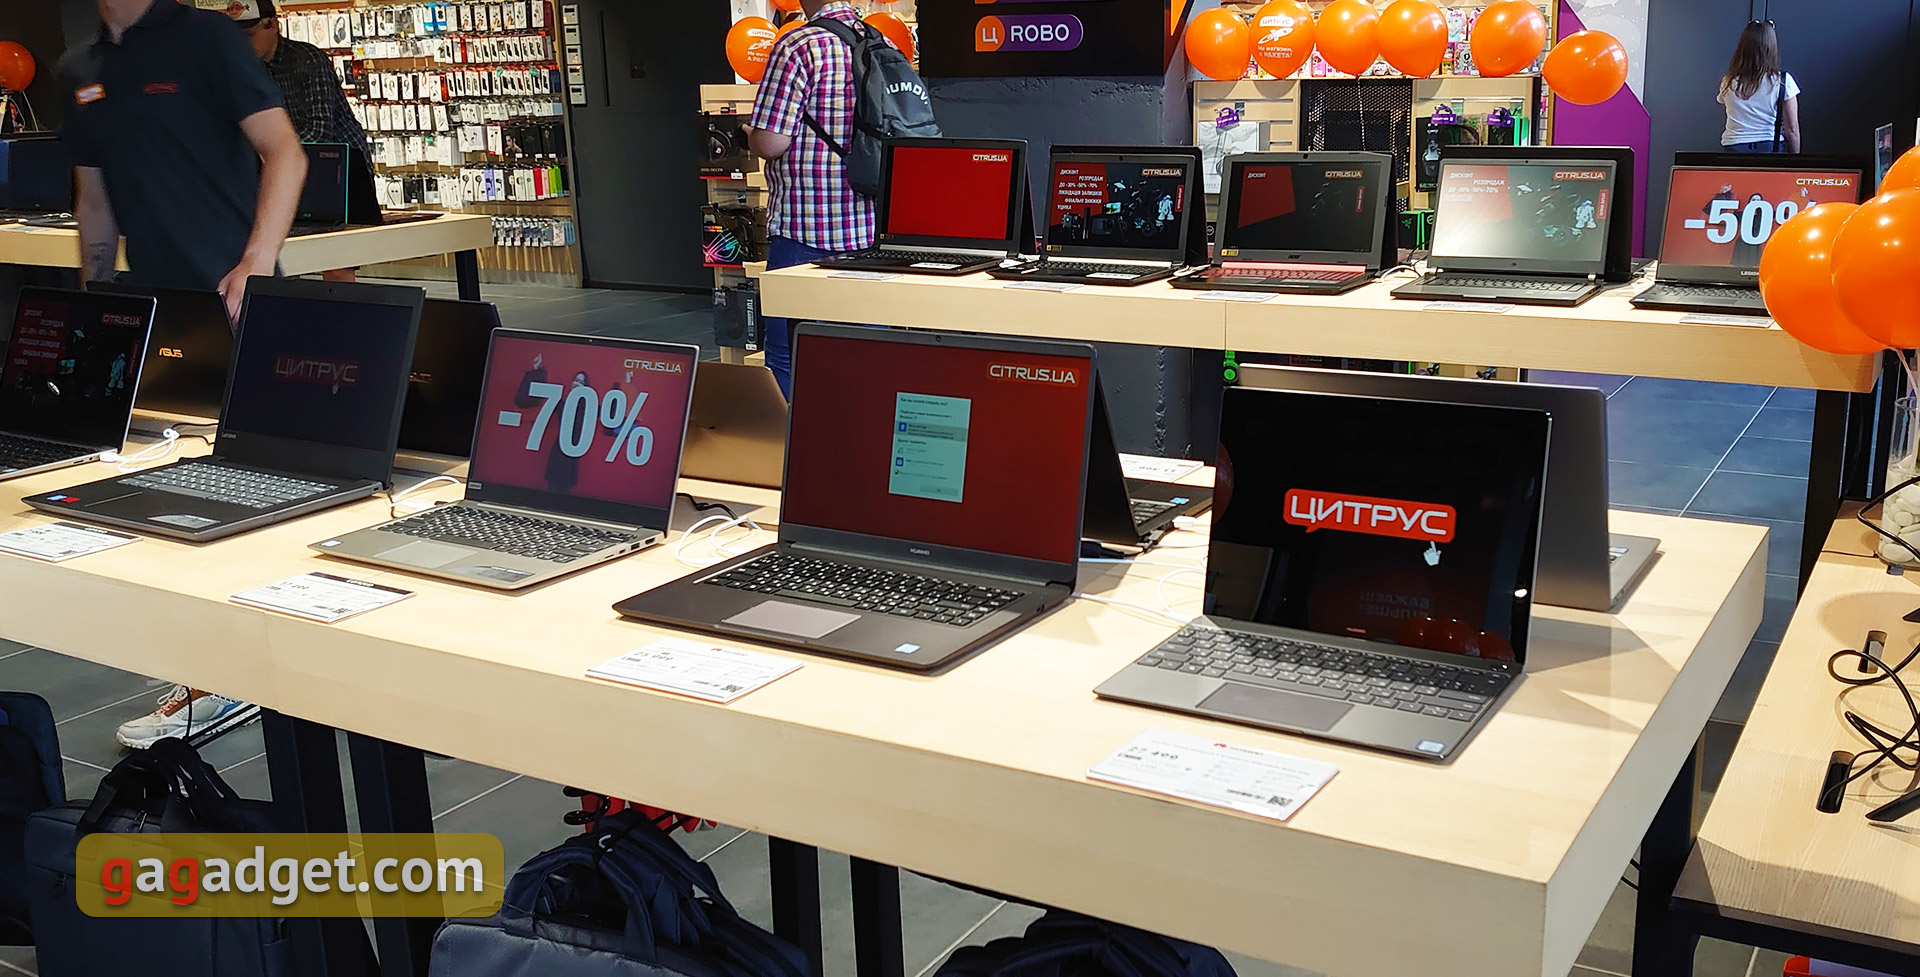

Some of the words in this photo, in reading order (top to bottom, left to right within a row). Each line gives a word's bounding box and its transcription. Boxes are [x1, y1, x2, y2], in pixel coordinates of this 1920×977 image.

[982, 27, 998, 44] Ц
[1010, 24, 1070, 42] ROBO
[275, 357, 359, 383] ЦИТРУС
[624, 358, 682, 374] CITRUS.UA
[989, 364, 1076, 384] CITRUS.UA
[498, 381, 654, 466] -70%
[1290, 495, 1449, 536] ЦИТРУС
